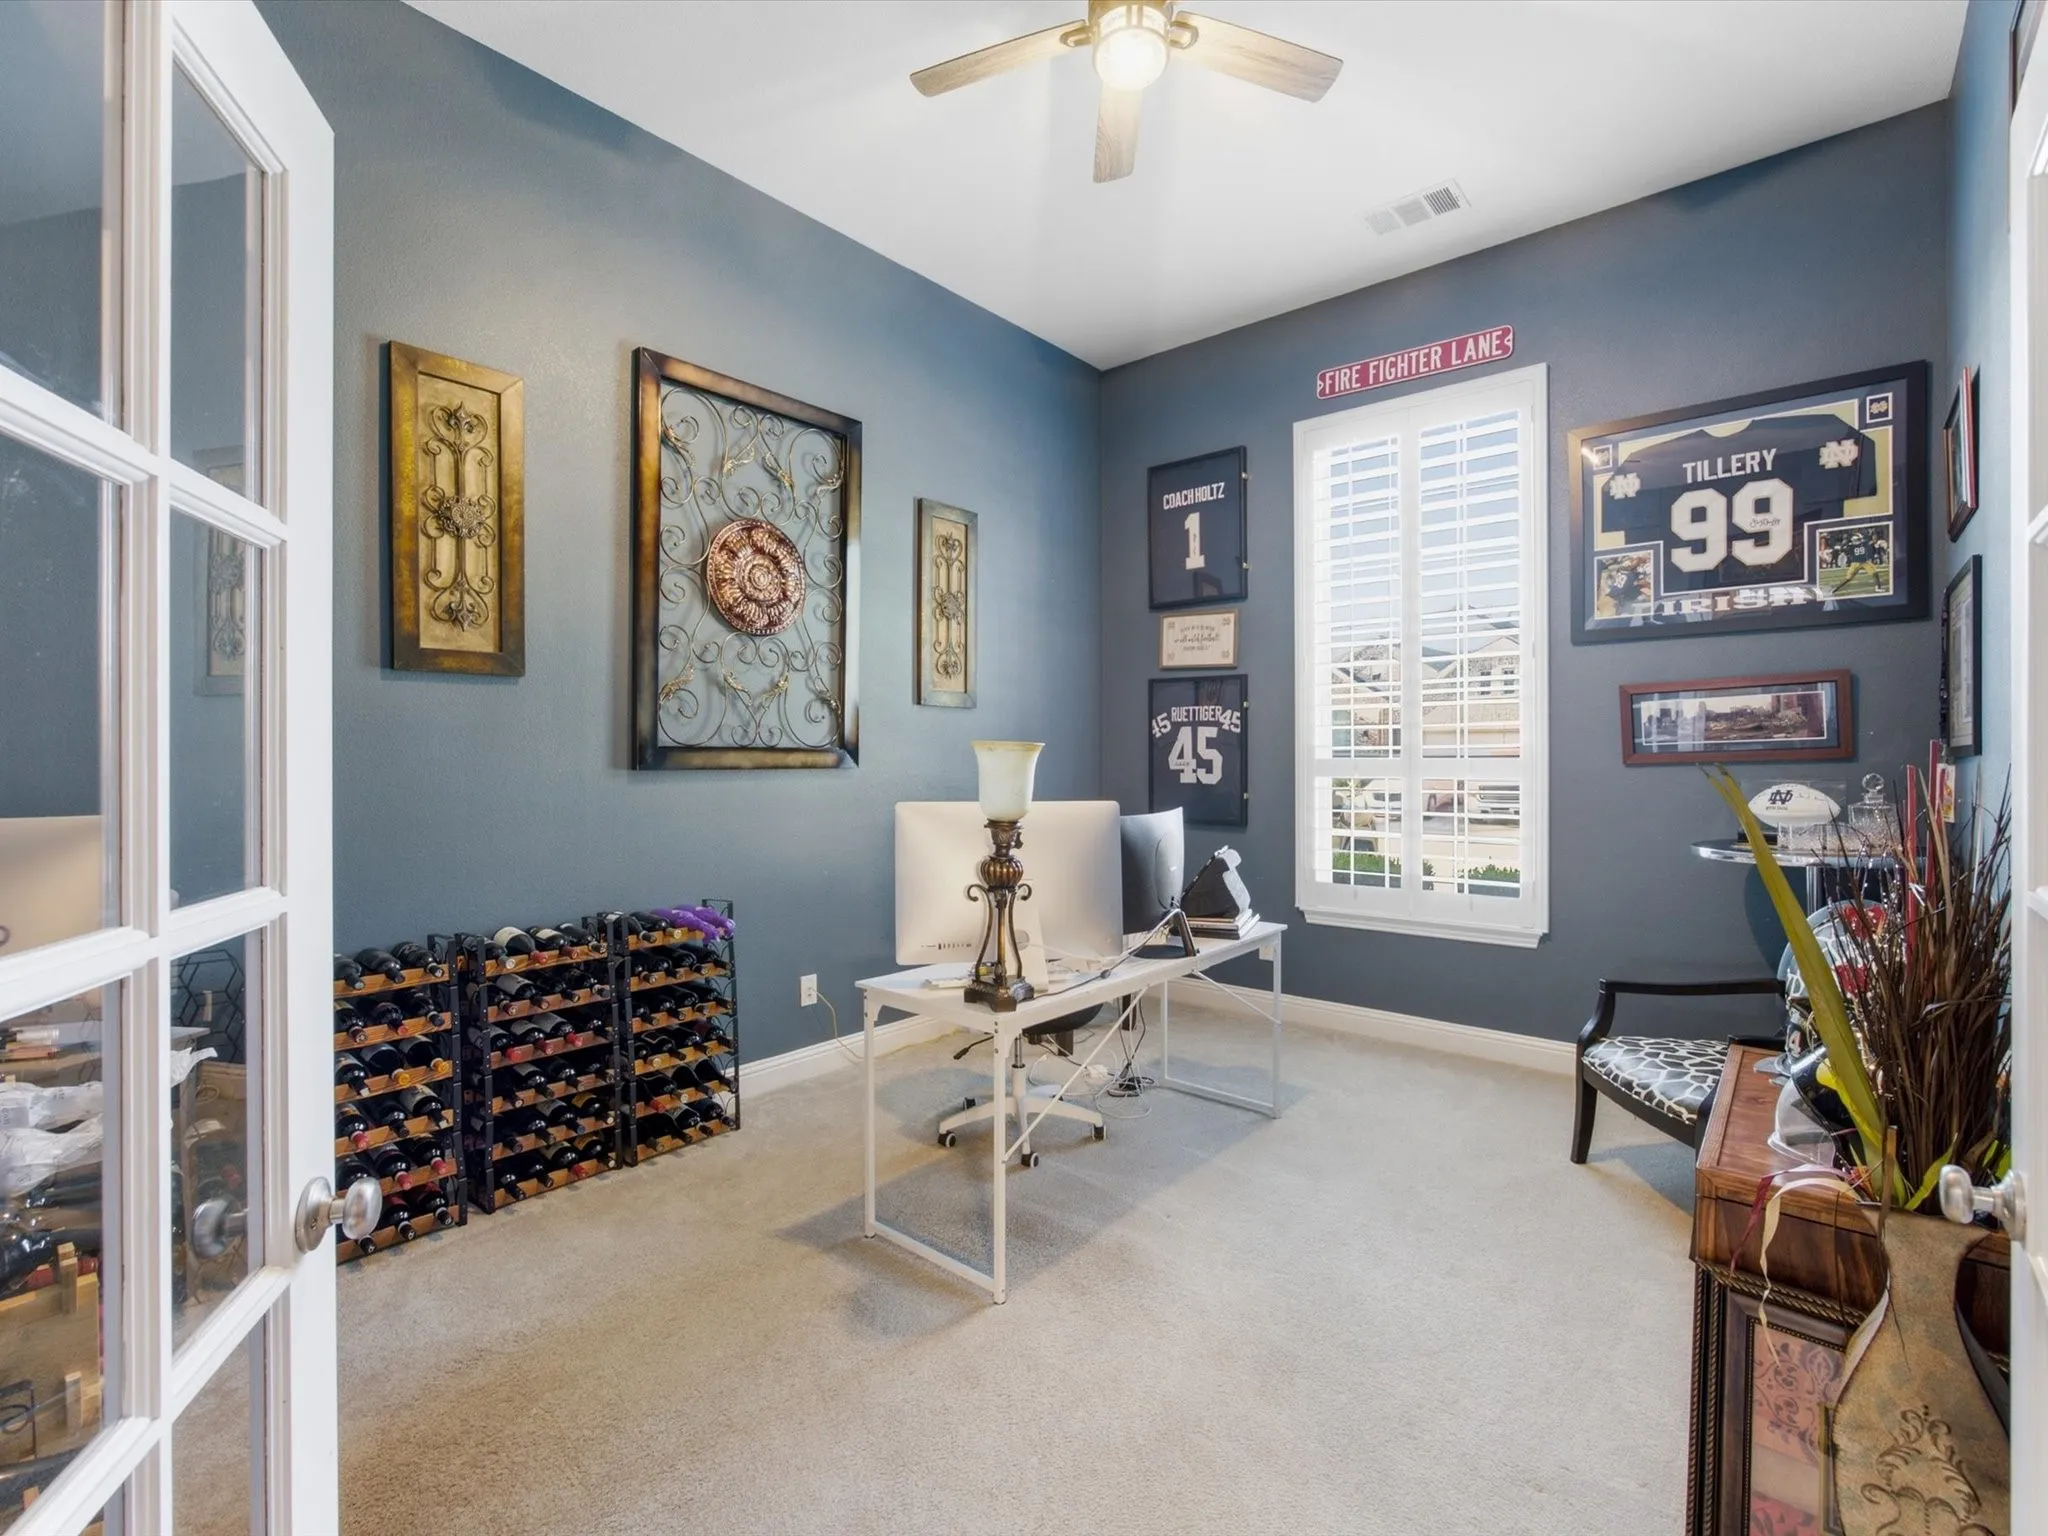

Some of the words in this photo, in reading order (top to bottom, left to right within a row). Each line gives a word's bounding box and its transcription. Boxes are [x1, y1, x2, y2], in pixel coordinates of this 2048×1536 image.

[1325, 365, 1361, 395] FIRE
[1369, 346, 1442, 385] FIGHTER
[1451, 330, 1503, 366] LANE
[1683, 448, 1777, 484] TILLERY
[1163, 488, 1195, 511] COACH
[1195, 482, 1225, 503] HOLTZ
[1184, 511, 1206, 570] 1
[1670, 478, 1794, 573] 99
[1854, 546, 1866, 556] 99
[1152, 712, 1172, 738] 45
[1171, 705, 1222, 722] RUETTIGER
[1219, 709, 1241, 733] 45
[1168, 726, 1224, 785] 45
